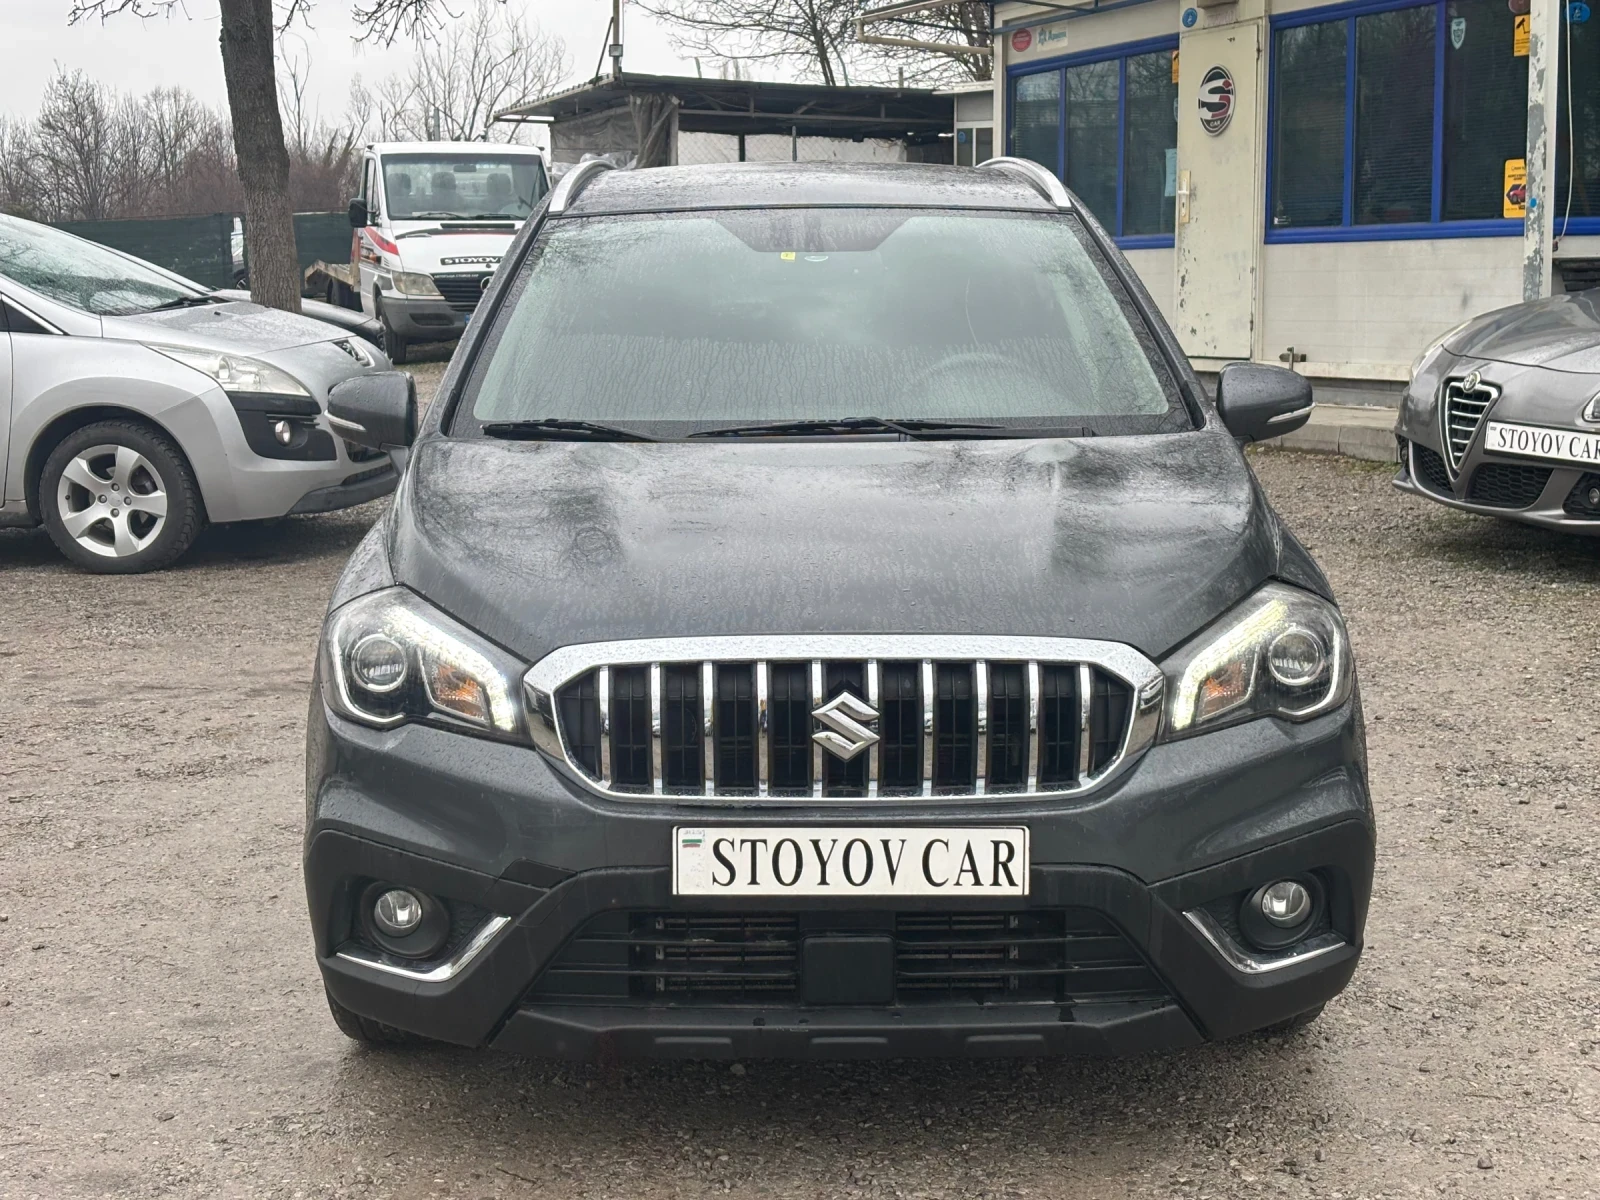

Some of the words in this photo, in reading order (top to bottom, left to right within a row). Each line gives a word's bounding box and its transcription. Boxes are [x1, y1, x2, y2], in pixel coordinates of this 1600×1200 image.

[1498, 427, 1565, 455] STOYOV
[712, 838, 907, 887] STOYOV
[922, 838, 1019, 887] CAR
